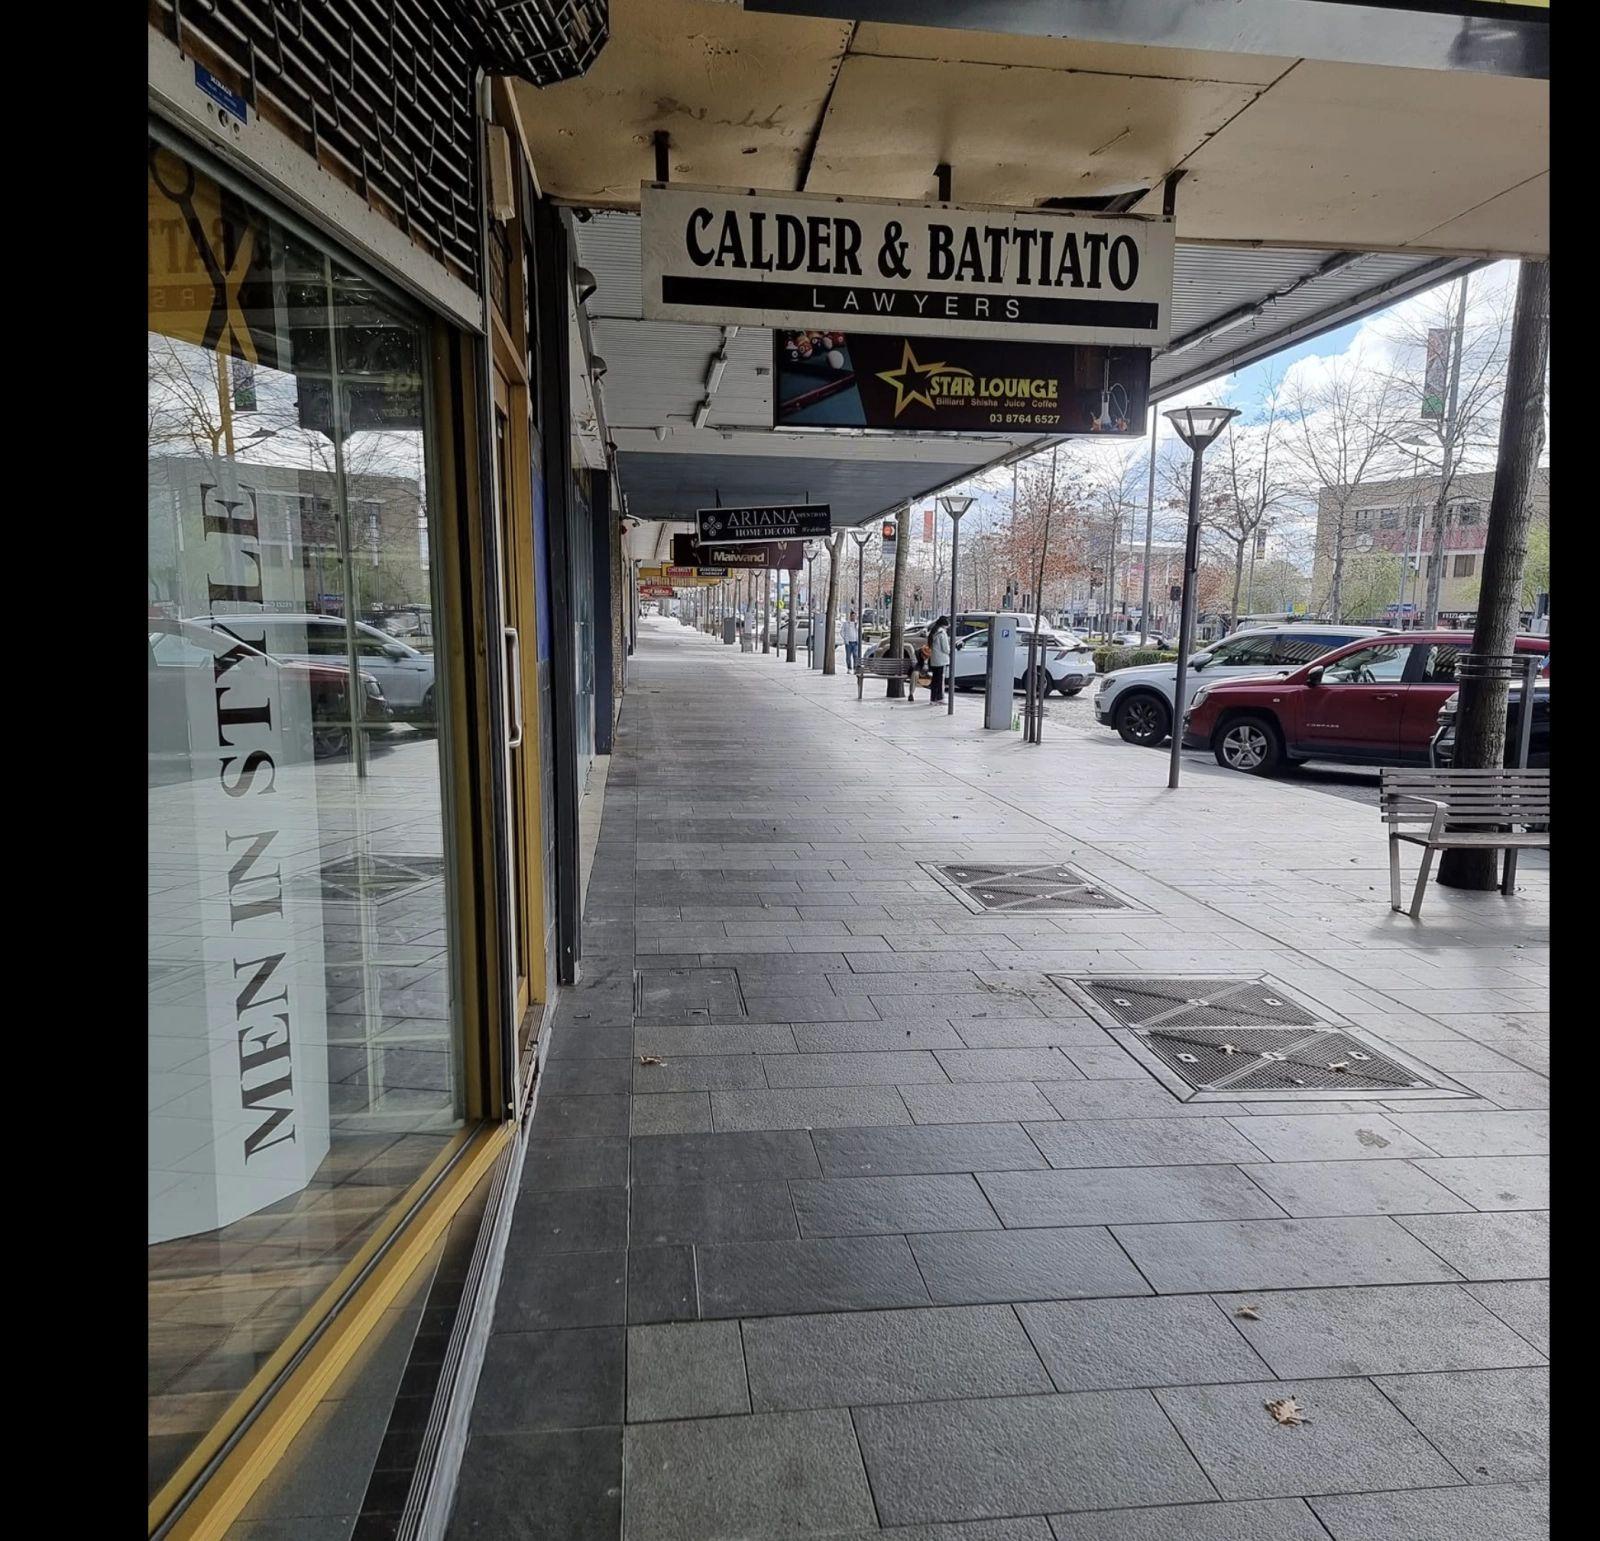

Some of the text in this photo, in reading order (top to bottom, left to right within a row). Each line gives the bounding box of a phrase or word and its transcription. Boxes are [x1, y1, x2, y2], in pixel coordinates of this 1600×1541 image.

[686, 207, 1140, 292] CALDER & BATTIATO
[812, 287, 1021, 320] LAWYERS
[930, 376, 1058, 399] STAR LOUNGE
[936, 397, 1058, 409] Billiard Shisha Juice Coffee
[989, 414, 1061, 424] 03 8764 6527
[728, 510, 798, 525] ARIANA
[735, 528, 764, 537] HOME
[764, 527, 797, 536] DECOR
[713, 550, 765, 562] Maiwand
[201, 483, 297, 1164] MEN IN STYLE
